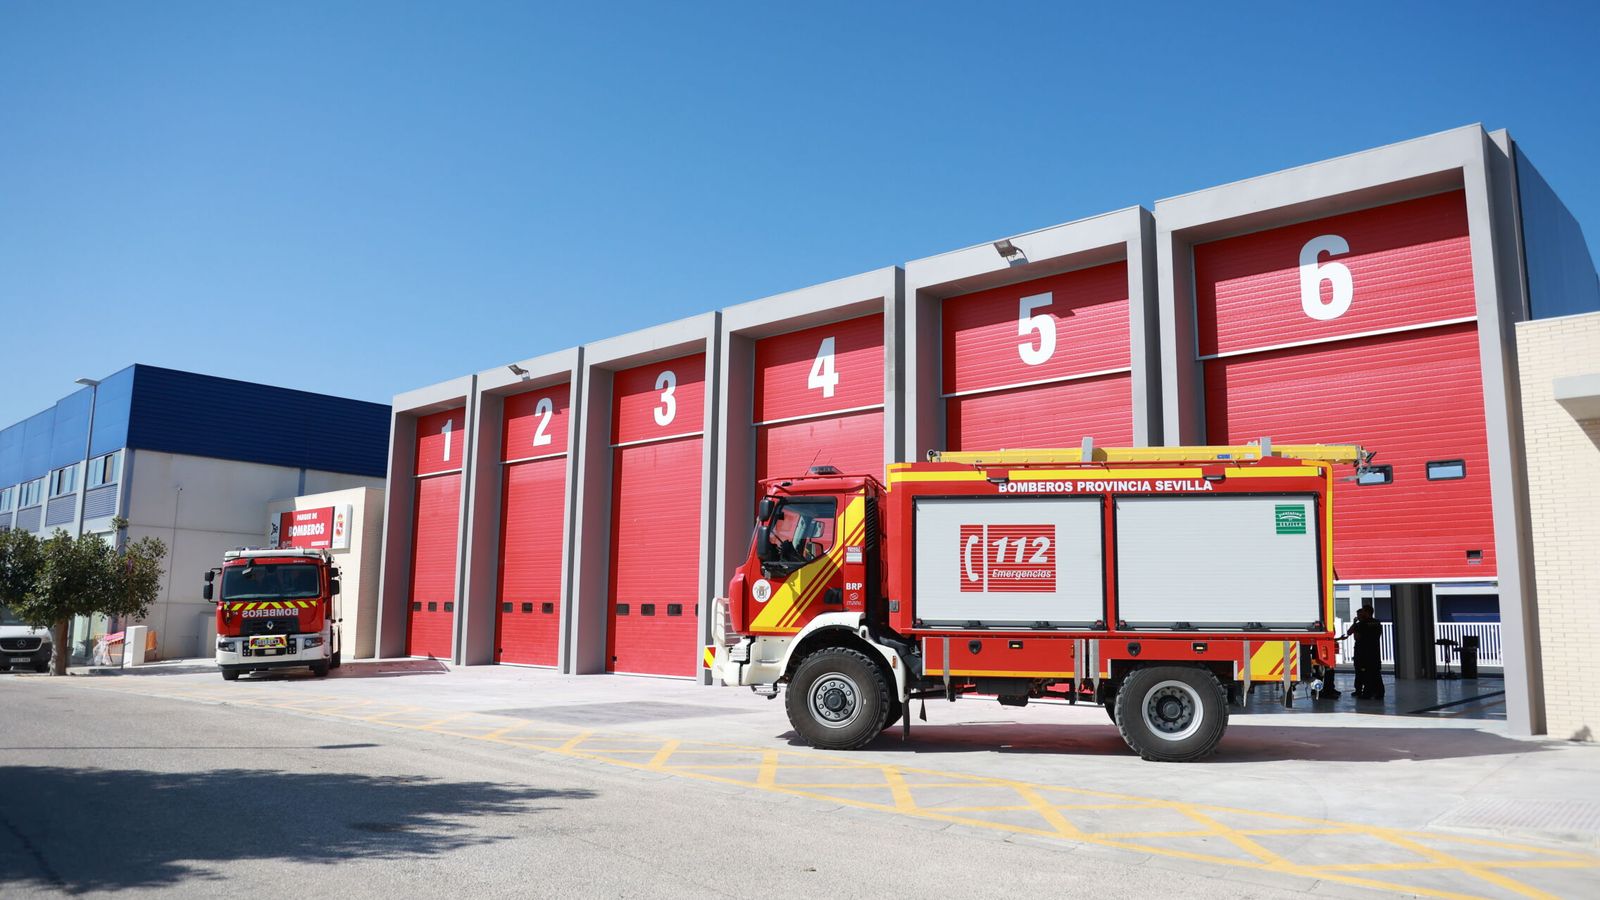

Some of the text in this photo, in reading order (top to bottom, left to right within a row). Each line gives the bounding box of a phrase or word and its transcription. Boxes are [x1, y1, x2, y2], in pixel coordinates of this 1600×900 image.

[1298, 235, 1355, 321] 6
[1017, 292, 1057, 365] 5
[807, 337, 840, 398] 4
[653, 370, 678, 427] 3
[441, 419, 452, 462] 1
[532, 397, 553, 447] 2
[998, 480, 1213, 493] BOMBEROS PROVINCIA SEVILLA
[288, 522, 325, 537] BOMBEROS
[992, 536, 1051, 563] 112
[845, 582, 863, 591] BRP
[992, 569, 1052, 580] Emergencias
